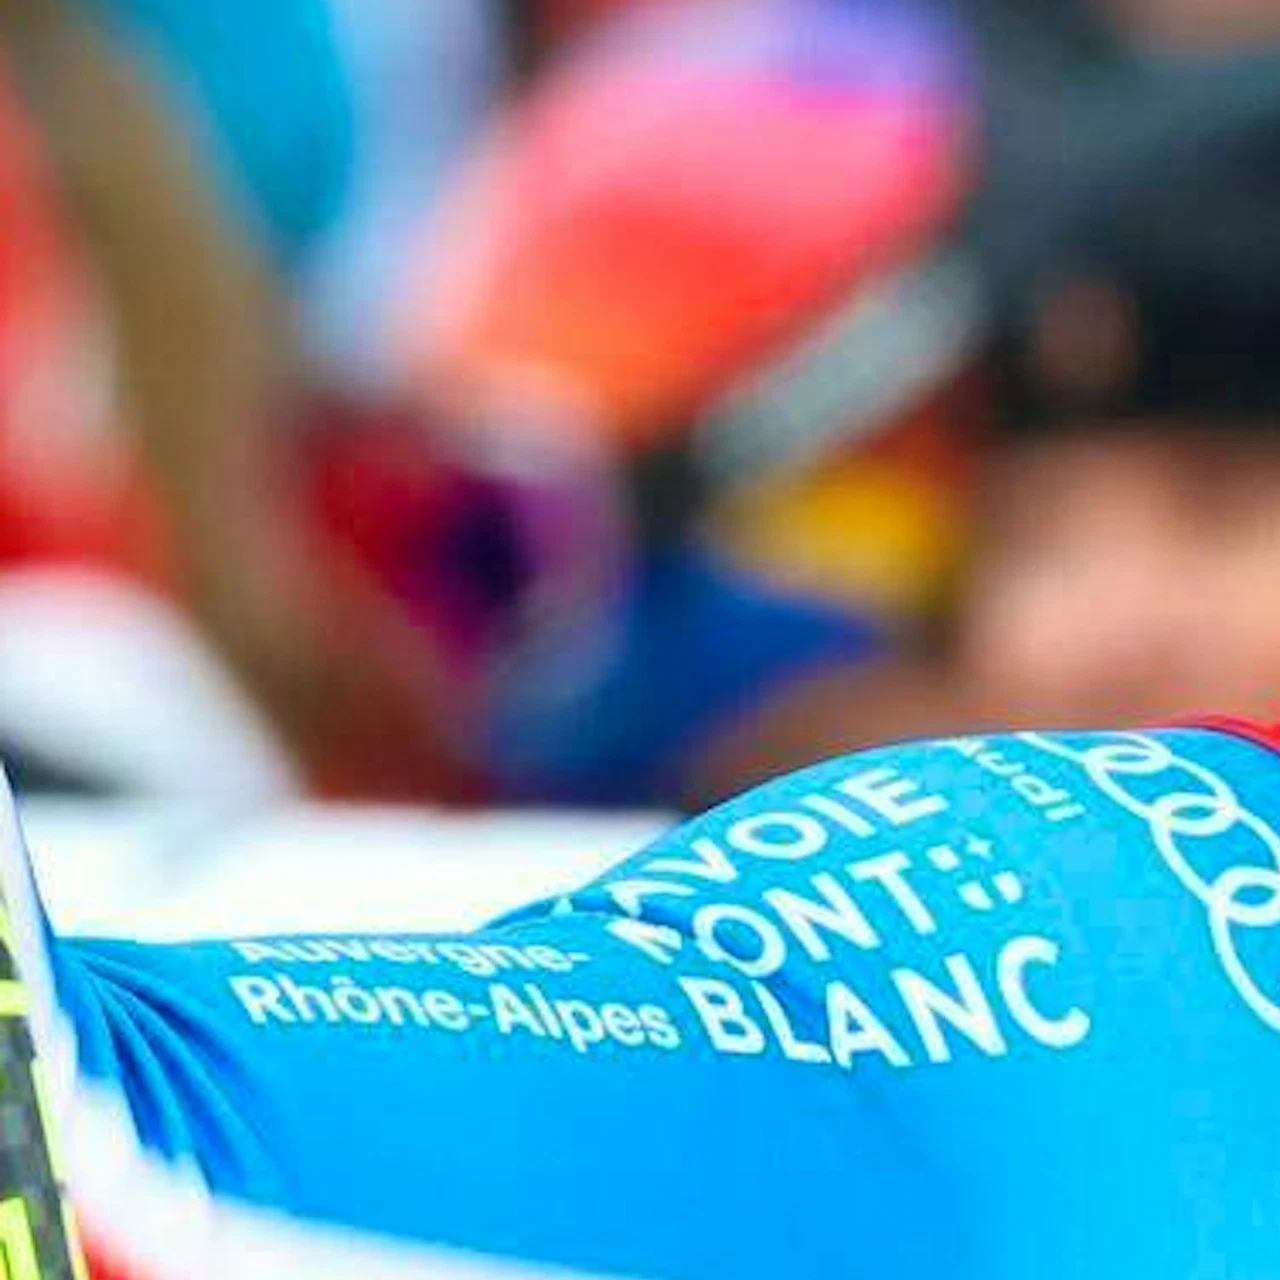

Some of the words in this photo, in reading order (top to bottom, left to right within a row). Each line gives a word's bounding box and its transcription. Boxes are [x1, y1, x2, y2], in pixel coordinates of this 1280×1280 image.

[553, 767, 950, 917] AVOIE
[228, 974, 681, 1053] Rhône-Alpes
[677, 934, 1092, 1068] BLANC
